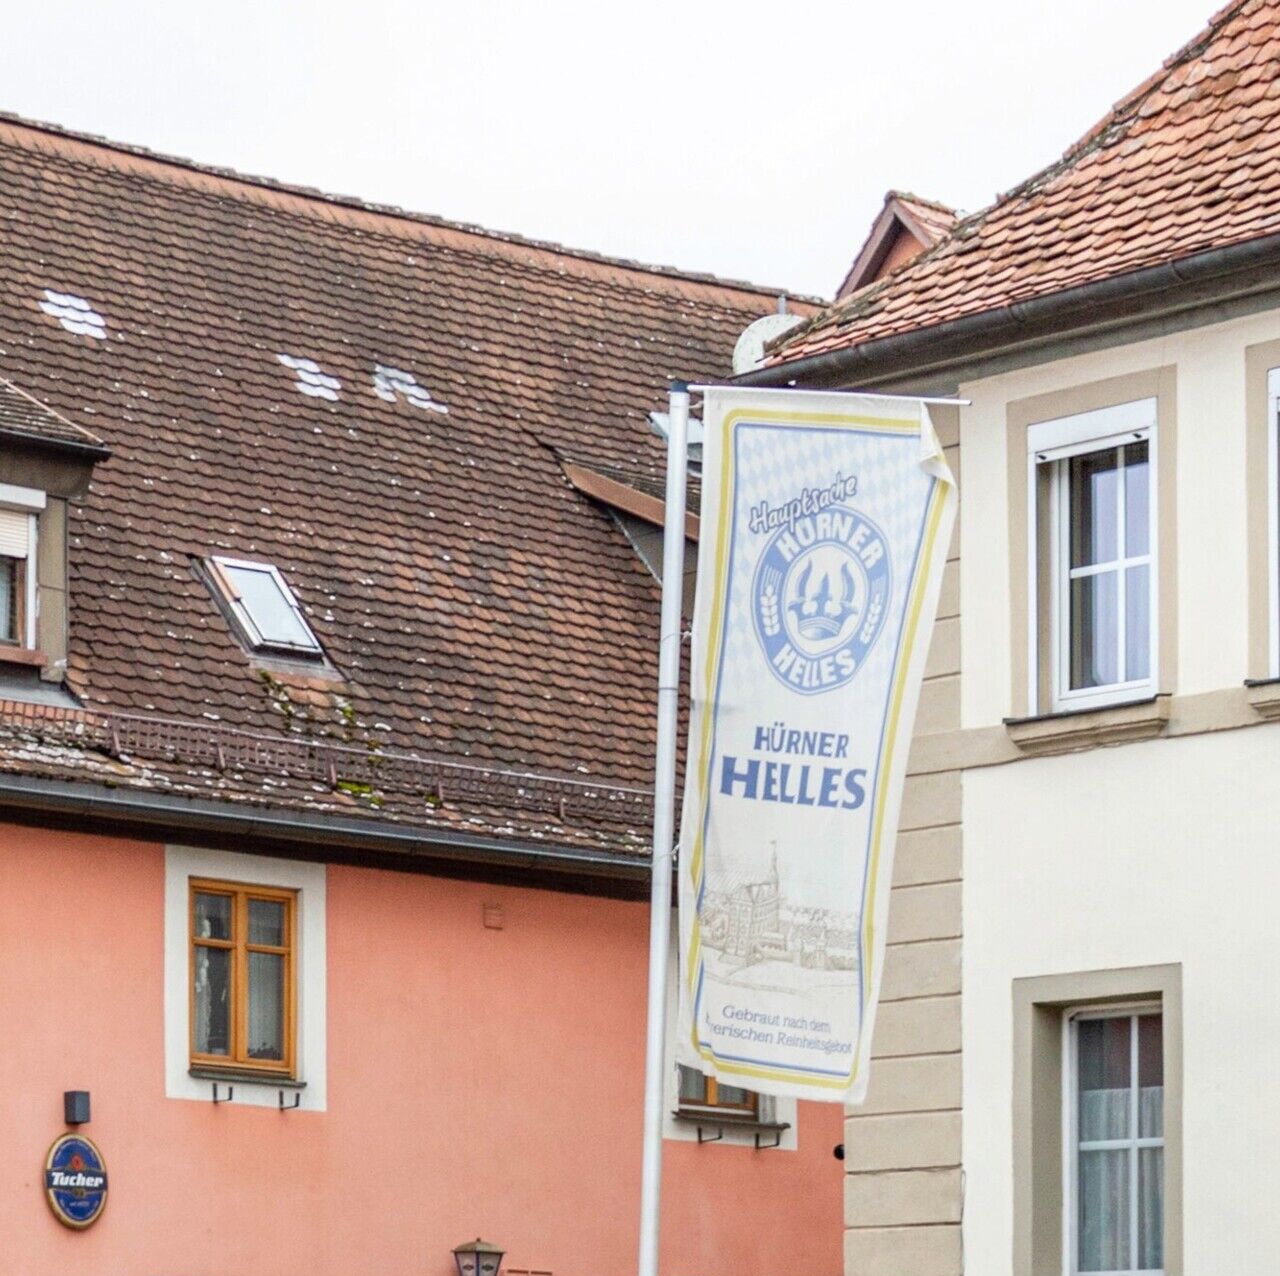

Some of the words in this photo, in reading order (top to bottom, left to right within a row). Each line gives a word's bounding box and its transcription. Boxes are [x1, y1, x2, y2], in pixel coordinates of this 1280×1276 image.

[749, 471, 857, 535] Hauptsache
[773, 642, 856, 688] HELLES
[754, 721, 849, 759] HÜRNER
[720, 755, 867, 810] HELLES
[722, 1004, 780, 1026] Gebraut
[51, 1171, 103, 1187] Tucher
